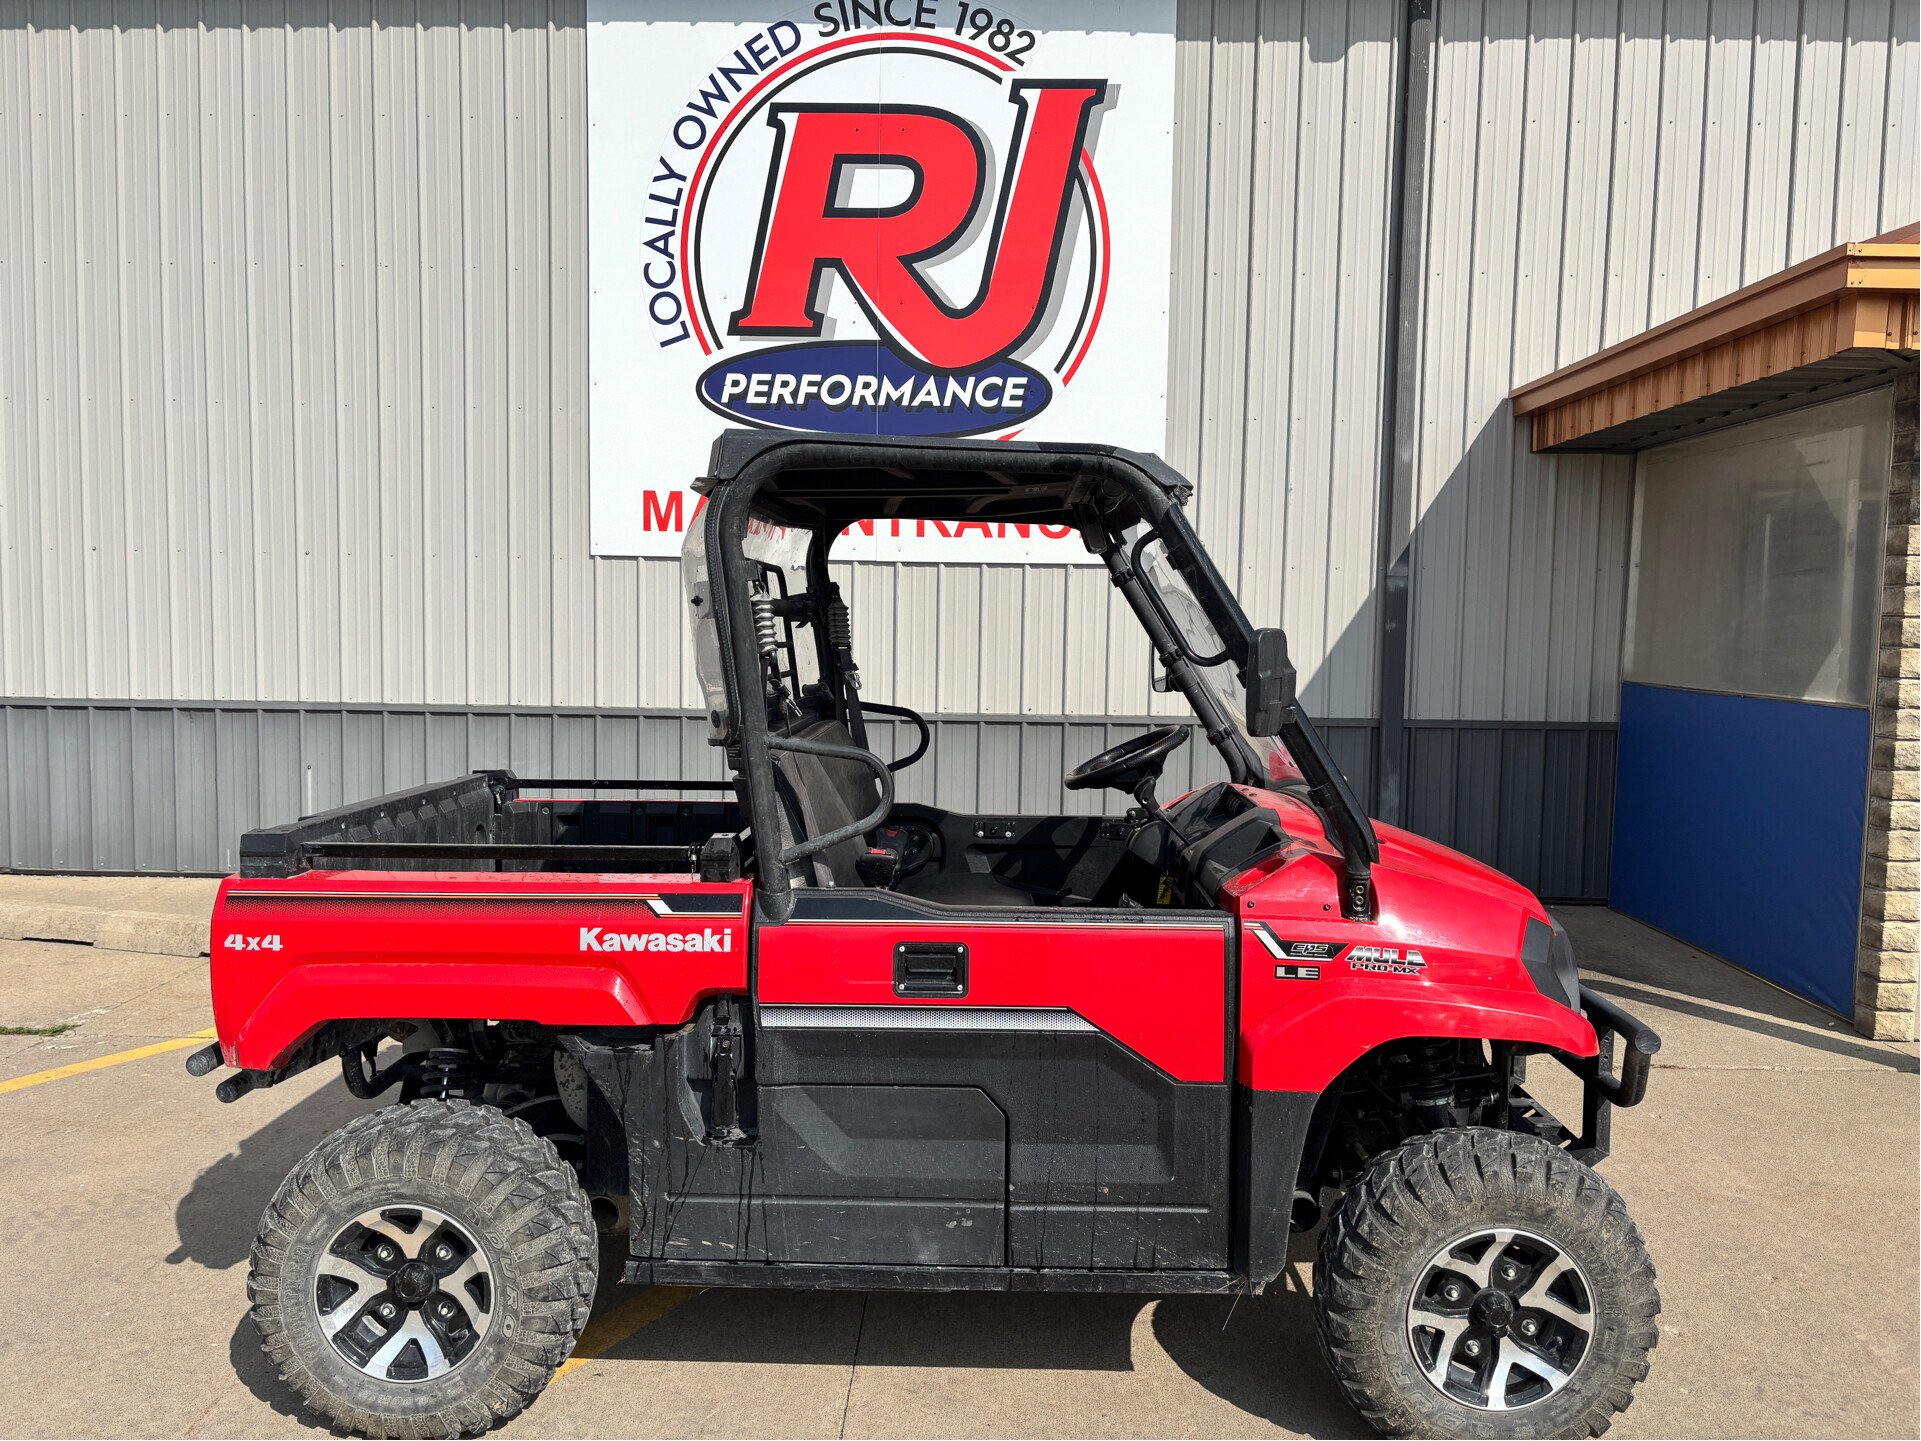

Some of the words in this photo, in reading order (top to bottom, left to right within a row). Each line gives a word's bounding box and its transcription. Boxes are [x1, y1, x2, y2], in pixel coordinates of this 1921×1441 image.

[643, 157, 691, 348] LOCALLY
[673, 20, 802, 150] OWNED
[814, 0, 937, 38] SINCE
[955, 1, 1036, 67] 1982
[727, 78, 1109, 377] RJ
[721, 373, 1027, 408] PERFORMANCE
[223, 933, 283, 951] 4x4
[579, 926, 732, 952] Kawasaki
[1344, 946, 1428, 967] MULE
[1276, 966, 1319, 979] LE
[1351, 962, 1420, 975] PRO-MX
